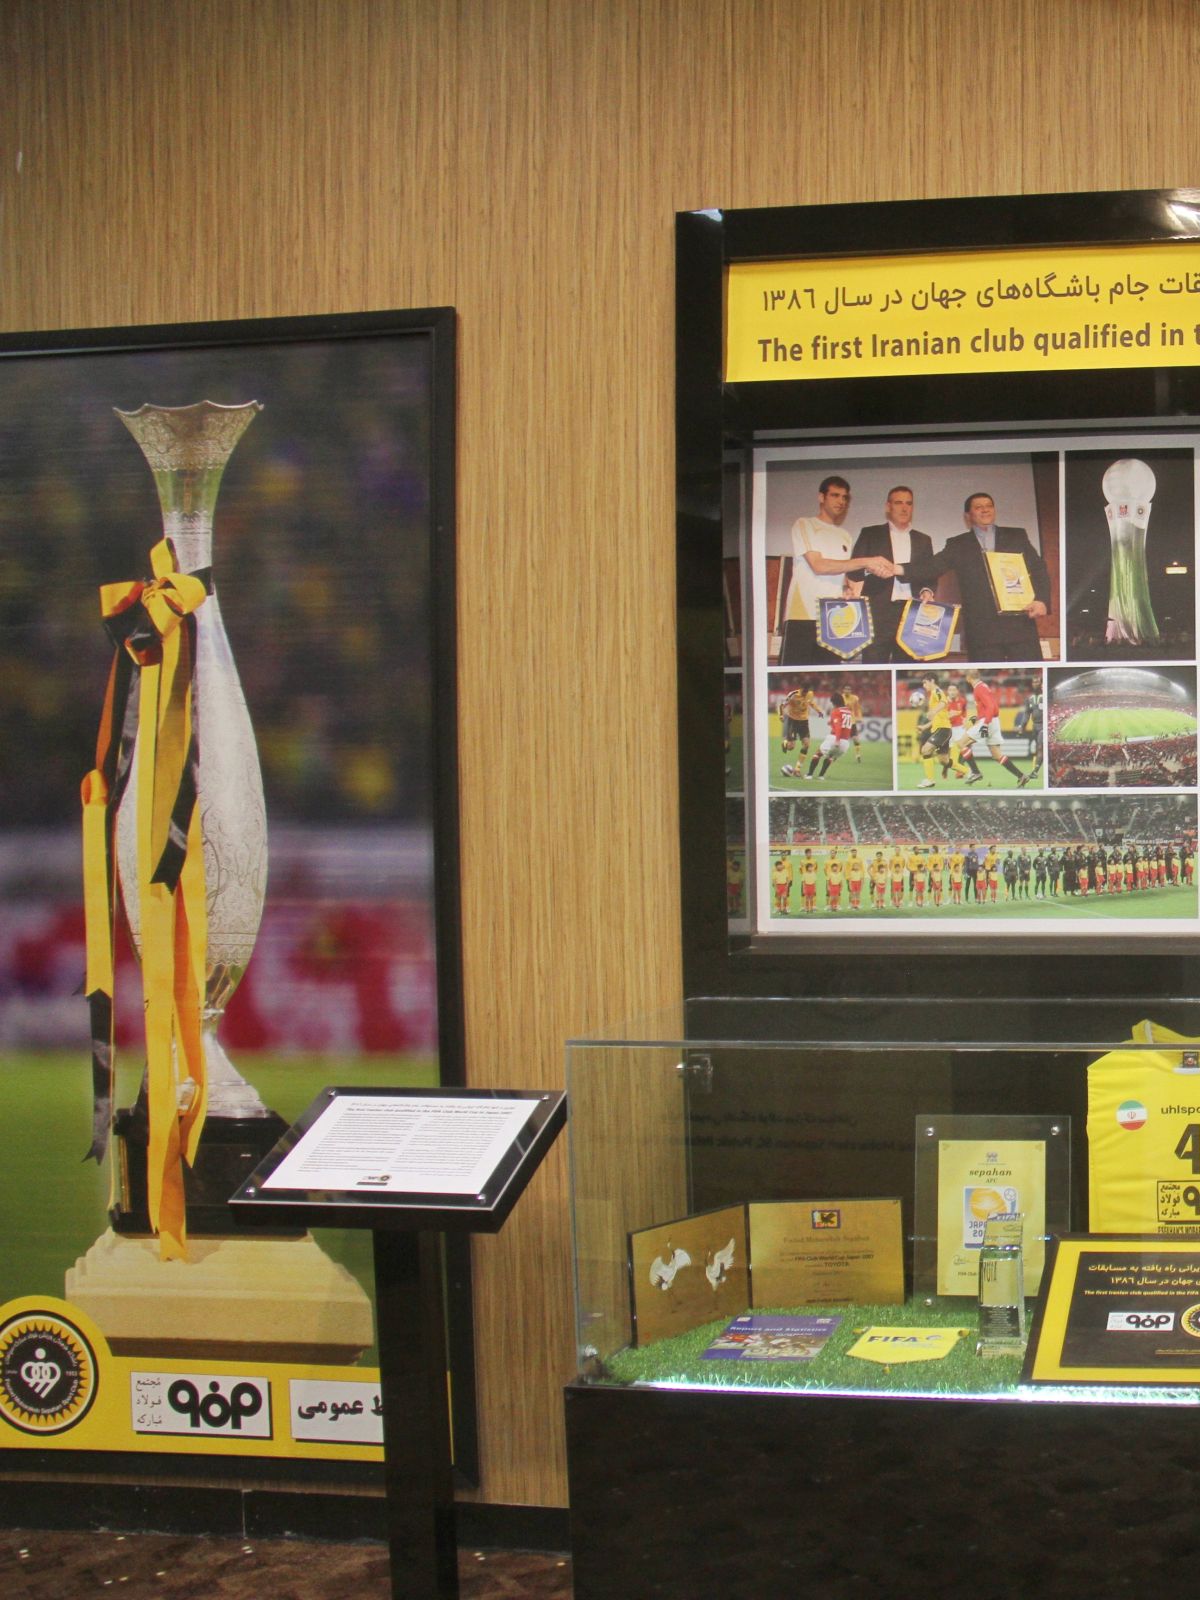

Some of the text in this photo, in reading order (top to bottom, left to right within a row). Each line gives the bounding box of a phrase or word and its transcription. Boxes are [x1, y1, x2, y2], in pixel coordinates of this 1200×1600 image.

[825, 287, 872, 314] سال
[880, 290, 902, 312] در
[912, 282, 966, 310] جهان
[1110, 274, 1148, 304] جام
[758, 338, 802, 362] The
[811, 335, 862, 360] first
[872, 331, 960, 357] Iranian
[971, 327, 1024, 352] club
[1034, 323, 1150, 356] qualified
[1162, 323, 1183, 346] in
[1174, 1124, 1200, 1174] 4
[969, 1168, 1012, 1178] sepahan
[298, 1399, 364, 1421] عمومی
